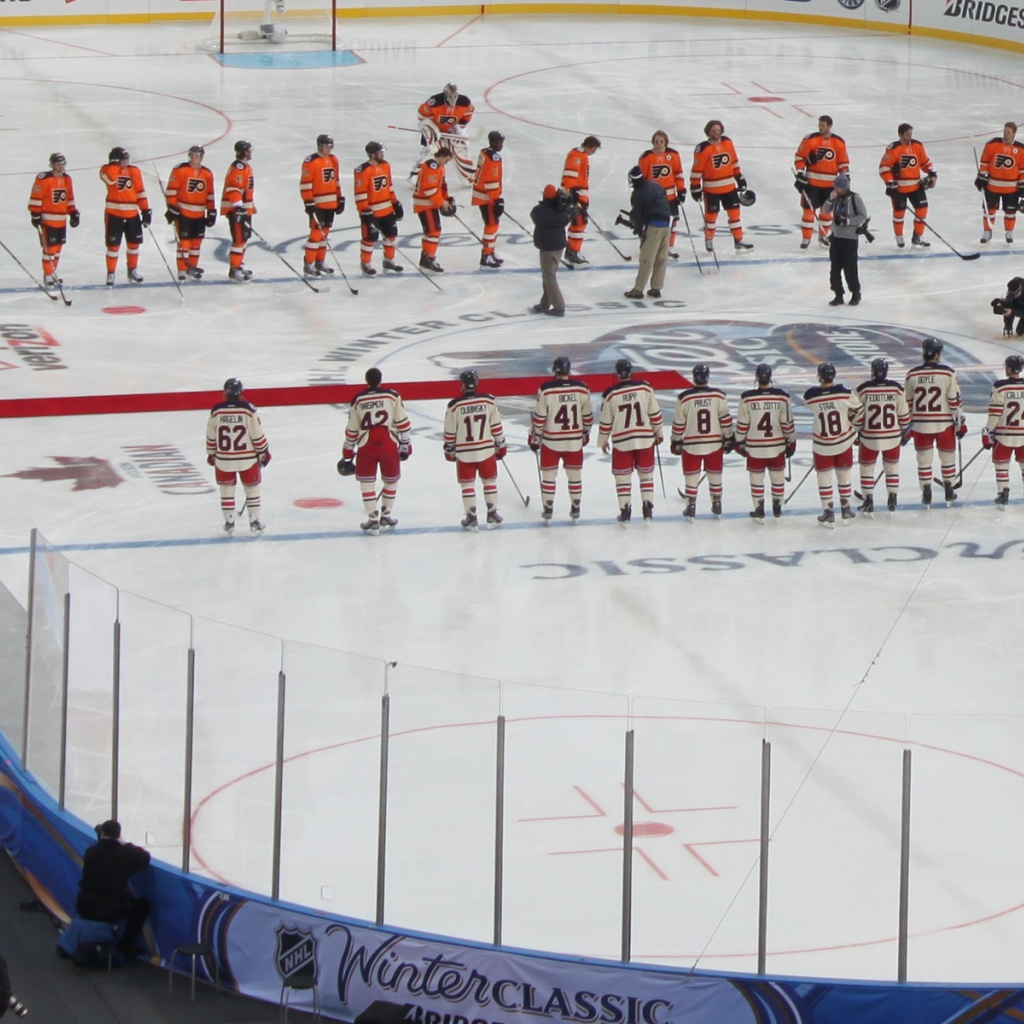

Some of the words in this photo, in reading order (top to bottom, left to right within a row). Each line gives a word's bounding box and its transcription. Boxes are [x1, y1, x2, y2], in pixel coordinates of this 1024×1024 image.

[917, 376, 936, 384] BOYLE
[460, 404, 487, 416] DUBINSKY
[558, 394, 578, 403] BICKEL
[622, 392, 638, 402] RUPP
[693, 398, 712, 408] PRUST
[818, 402, 837, 411] STAAL
[914, 386, 942, 413] 22
[219, 414, 244, 424] HAGELIN
[360, 409, 389, 431] 42
[463, 414, 487, 442] 17
[554, 404, 580, 431] 41
[618, 401, 644, 428] 71
[696, 408, 711, 435] 8
[756, 411, 774, 438] 4
[817, 409, 842, 437] 18
[867, 403, 896, 430] 26
[217, 424, 248, 452] 62
[284, 942, 313, 975] NHL
[325, 923, 492, 1006] Winter
[491, 978, 675, 1024] CLASSIC
